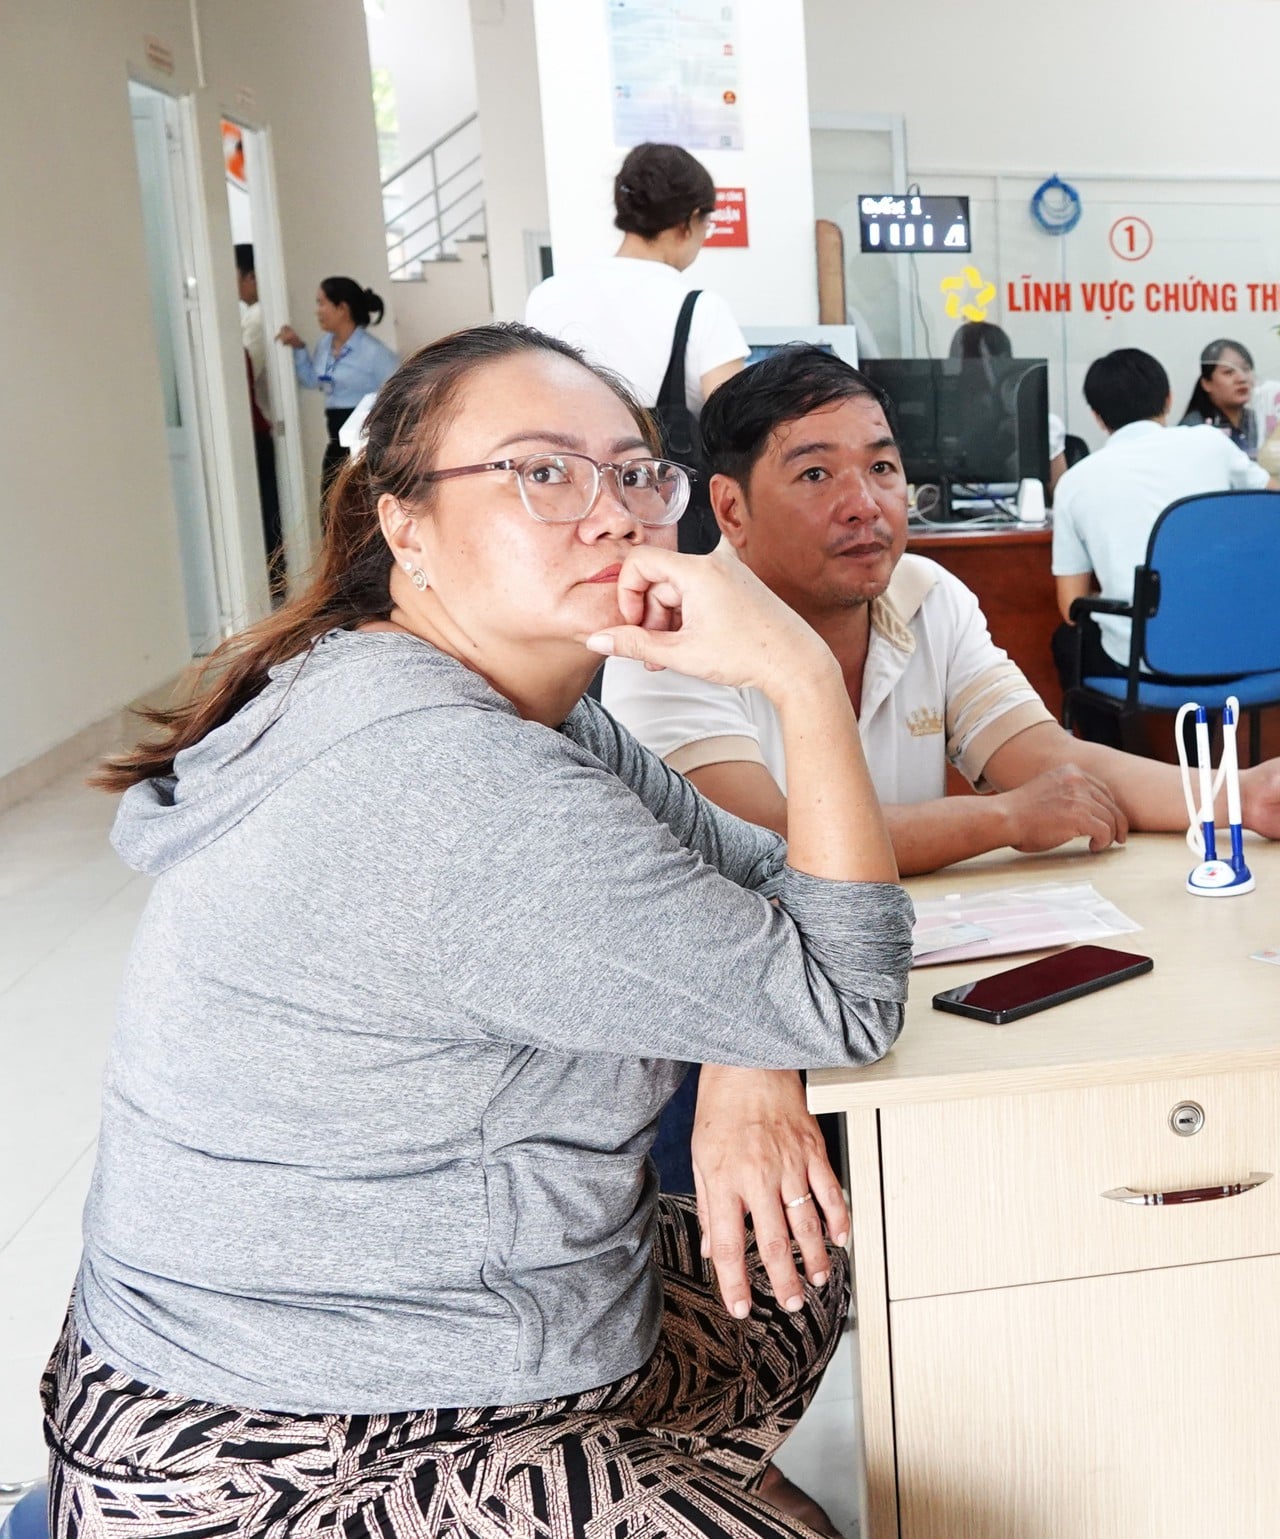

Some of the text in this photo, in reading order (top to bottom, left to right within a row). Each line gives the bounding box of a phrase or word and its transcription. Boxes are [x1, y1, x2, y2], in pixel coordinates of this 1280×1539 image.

[1124, 225, 1136, 252] 1
[1007, 275, 1072, 312] LĨNH
[1081, 280, 1135, 320] VỰC
[1145, 275, 1238, 312] CHỨNG
